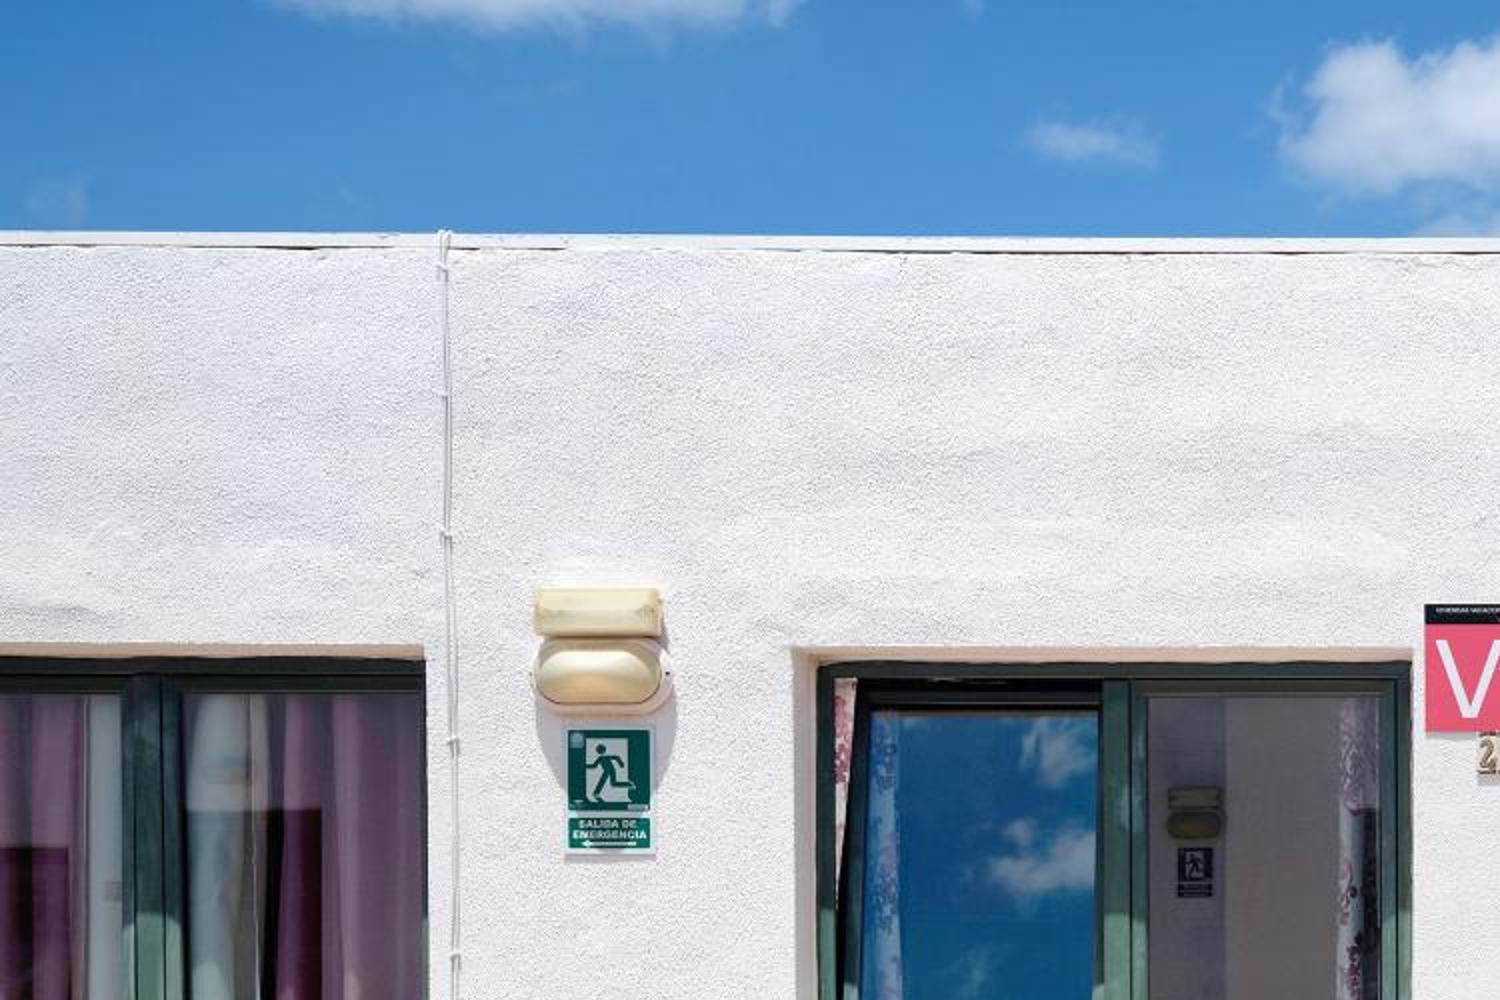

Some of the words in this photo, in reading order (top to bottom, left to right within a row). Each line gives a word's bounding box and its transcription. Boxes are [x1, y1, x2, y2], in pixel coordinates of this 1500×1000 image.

[579, 819, 619, 829] SALIDA
[621, 819, 637, 829] DE
[572, 829, 648, 839] EMERGENCIA
